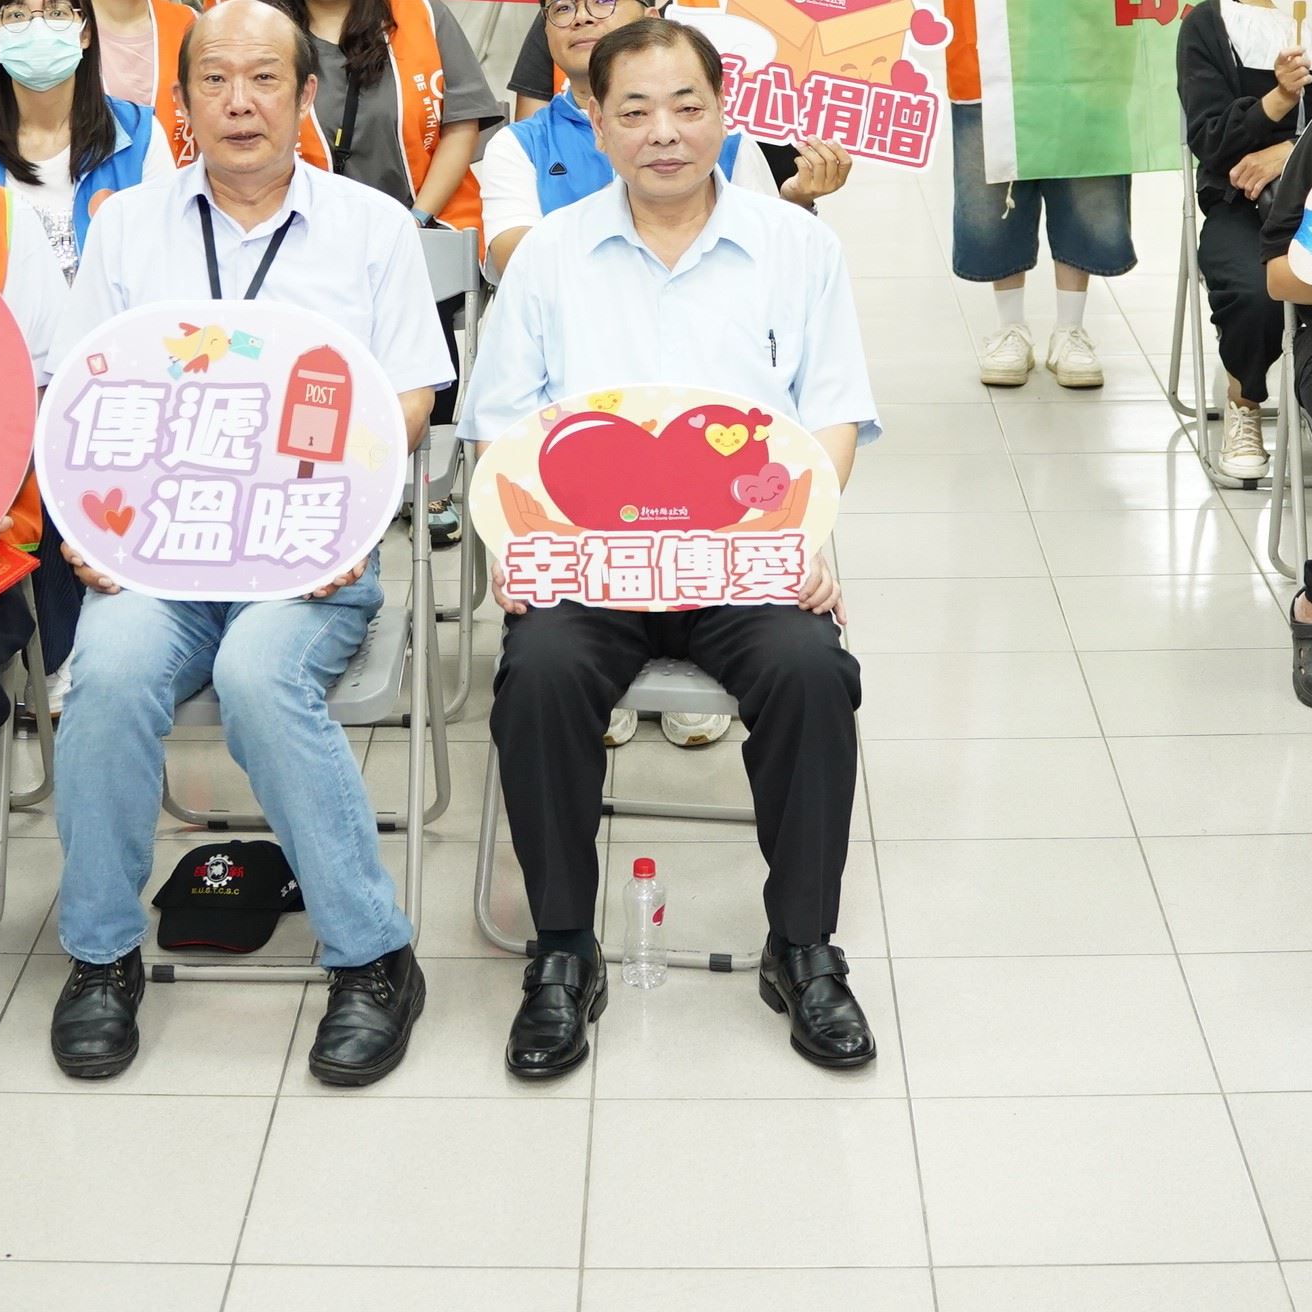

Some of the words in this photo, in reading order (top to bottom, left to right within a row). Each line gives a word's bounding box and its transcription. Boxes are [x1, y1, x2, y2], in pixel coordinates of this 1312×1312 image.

[412, 73, 427, 92] BE
[423, 96, 439, 129] WITH
[71, 384, 266, 471] 傳遞
[304, 383, 337, 406] POST
[138, 479, 346, 565] 溫暖
[507, 535, 806, 605] 幸福傳愛
